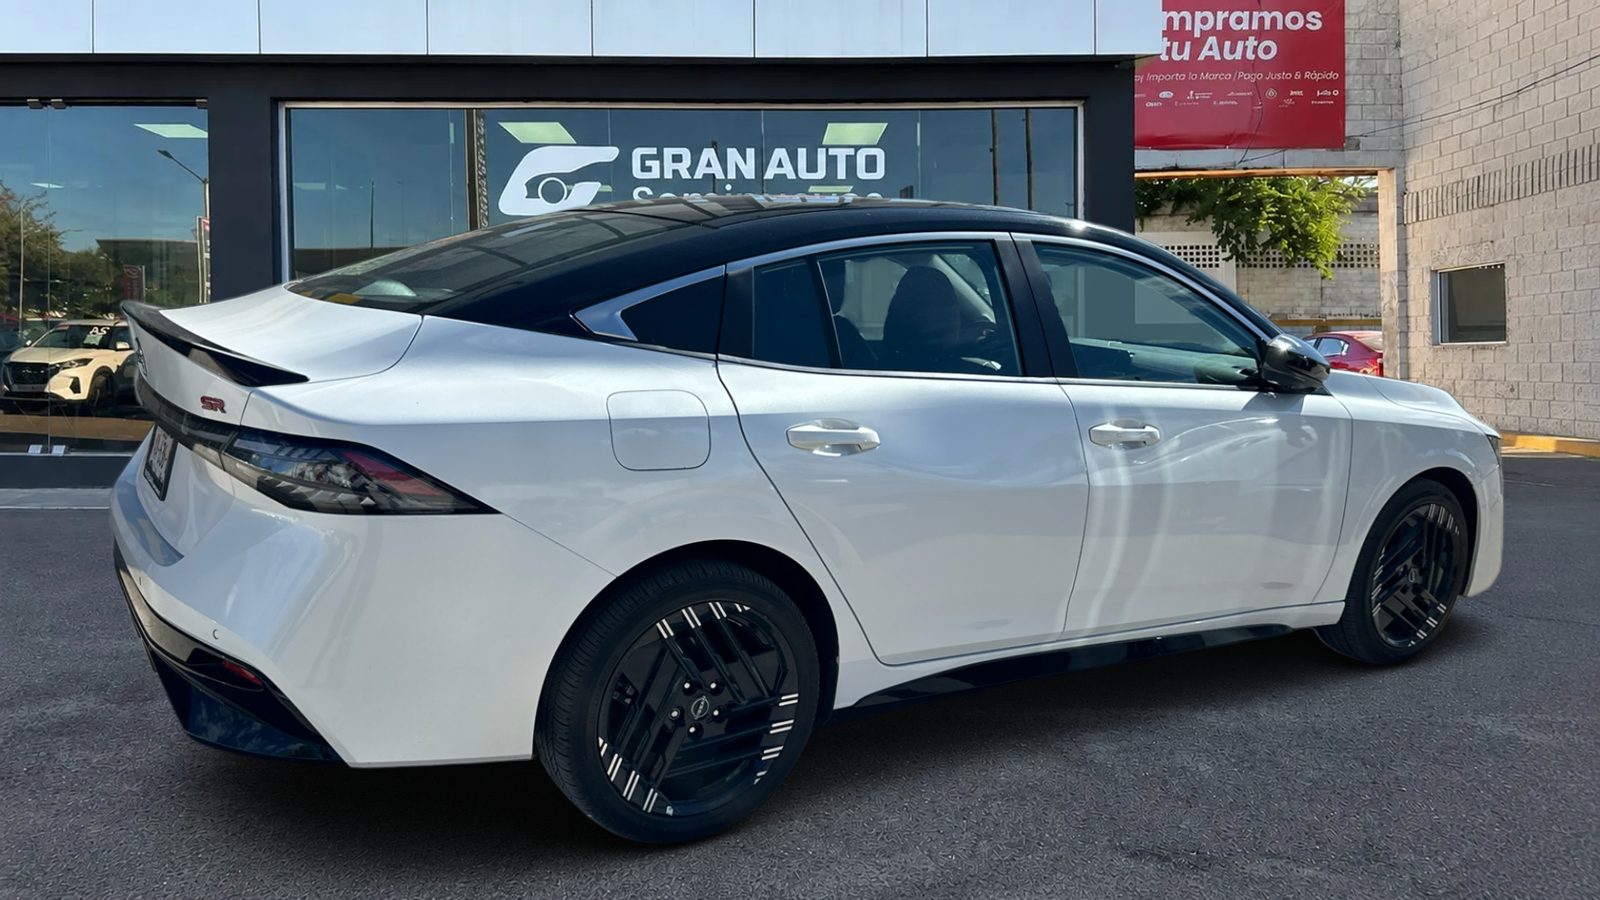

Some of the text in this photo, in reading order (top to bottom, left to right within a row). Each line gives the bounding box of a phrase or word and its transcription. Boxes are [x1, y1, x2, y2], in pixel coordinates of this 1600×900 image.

[1162, 10, 1323, 38] mpramos
[1160, 36, 1278, 61] tu Auto
[1146, 72, 1186, 83] Importa
[1188, 72, 1198, 81] la
[1199, 72, 1231, 81] Marca
[1265, 72, 1292, 80] Justo
[1294, 71, 1301, 80] &
[1304, 70, 1339, 82] Rápido
[632, 147, 886, 180] GRAN AUTO
[200, 395, 226, 414] SR
